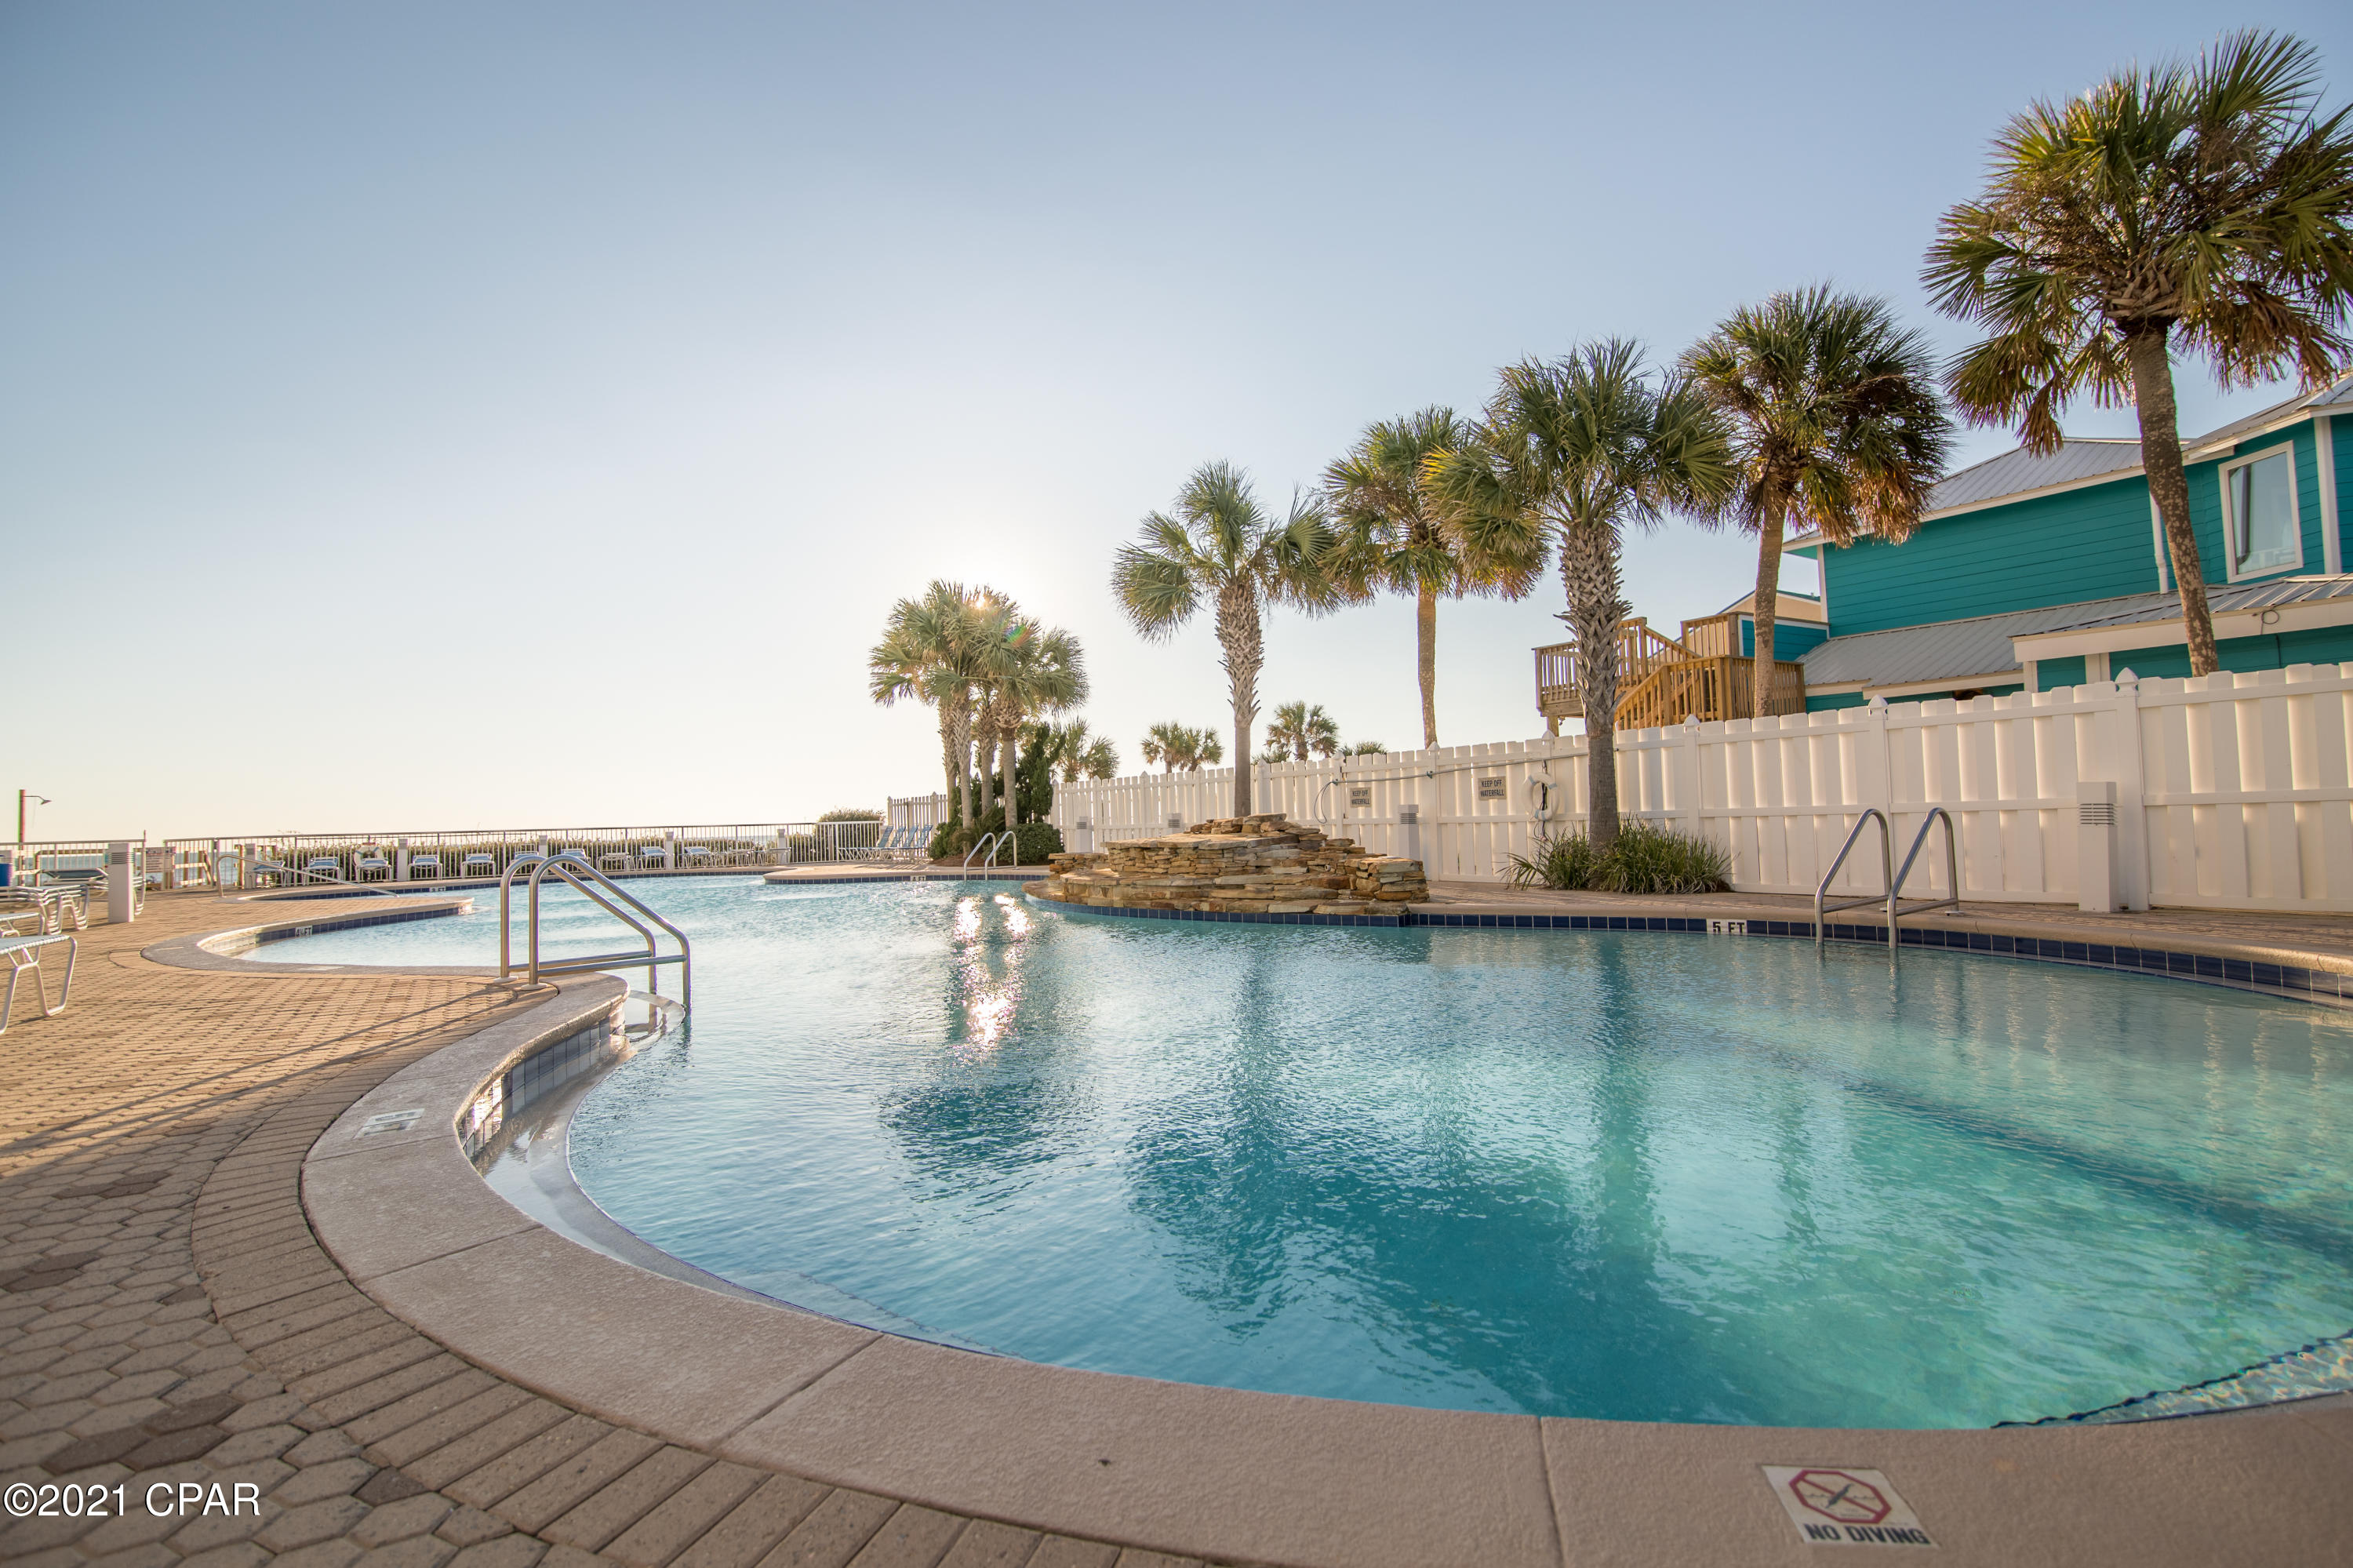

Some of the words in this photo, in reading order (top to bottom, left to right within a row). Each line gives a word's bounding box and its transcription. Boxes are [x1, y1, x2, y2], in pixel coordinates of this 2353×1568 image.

[1481, 788, 1504, 797] WATERFALL
[1712, 921, 1722, 934] 5
[1728, 922, 1745, 934] FT
[1803, 1523, 1842, 1541] NO
[1844, 1525, 1932, 1544] DIVING
